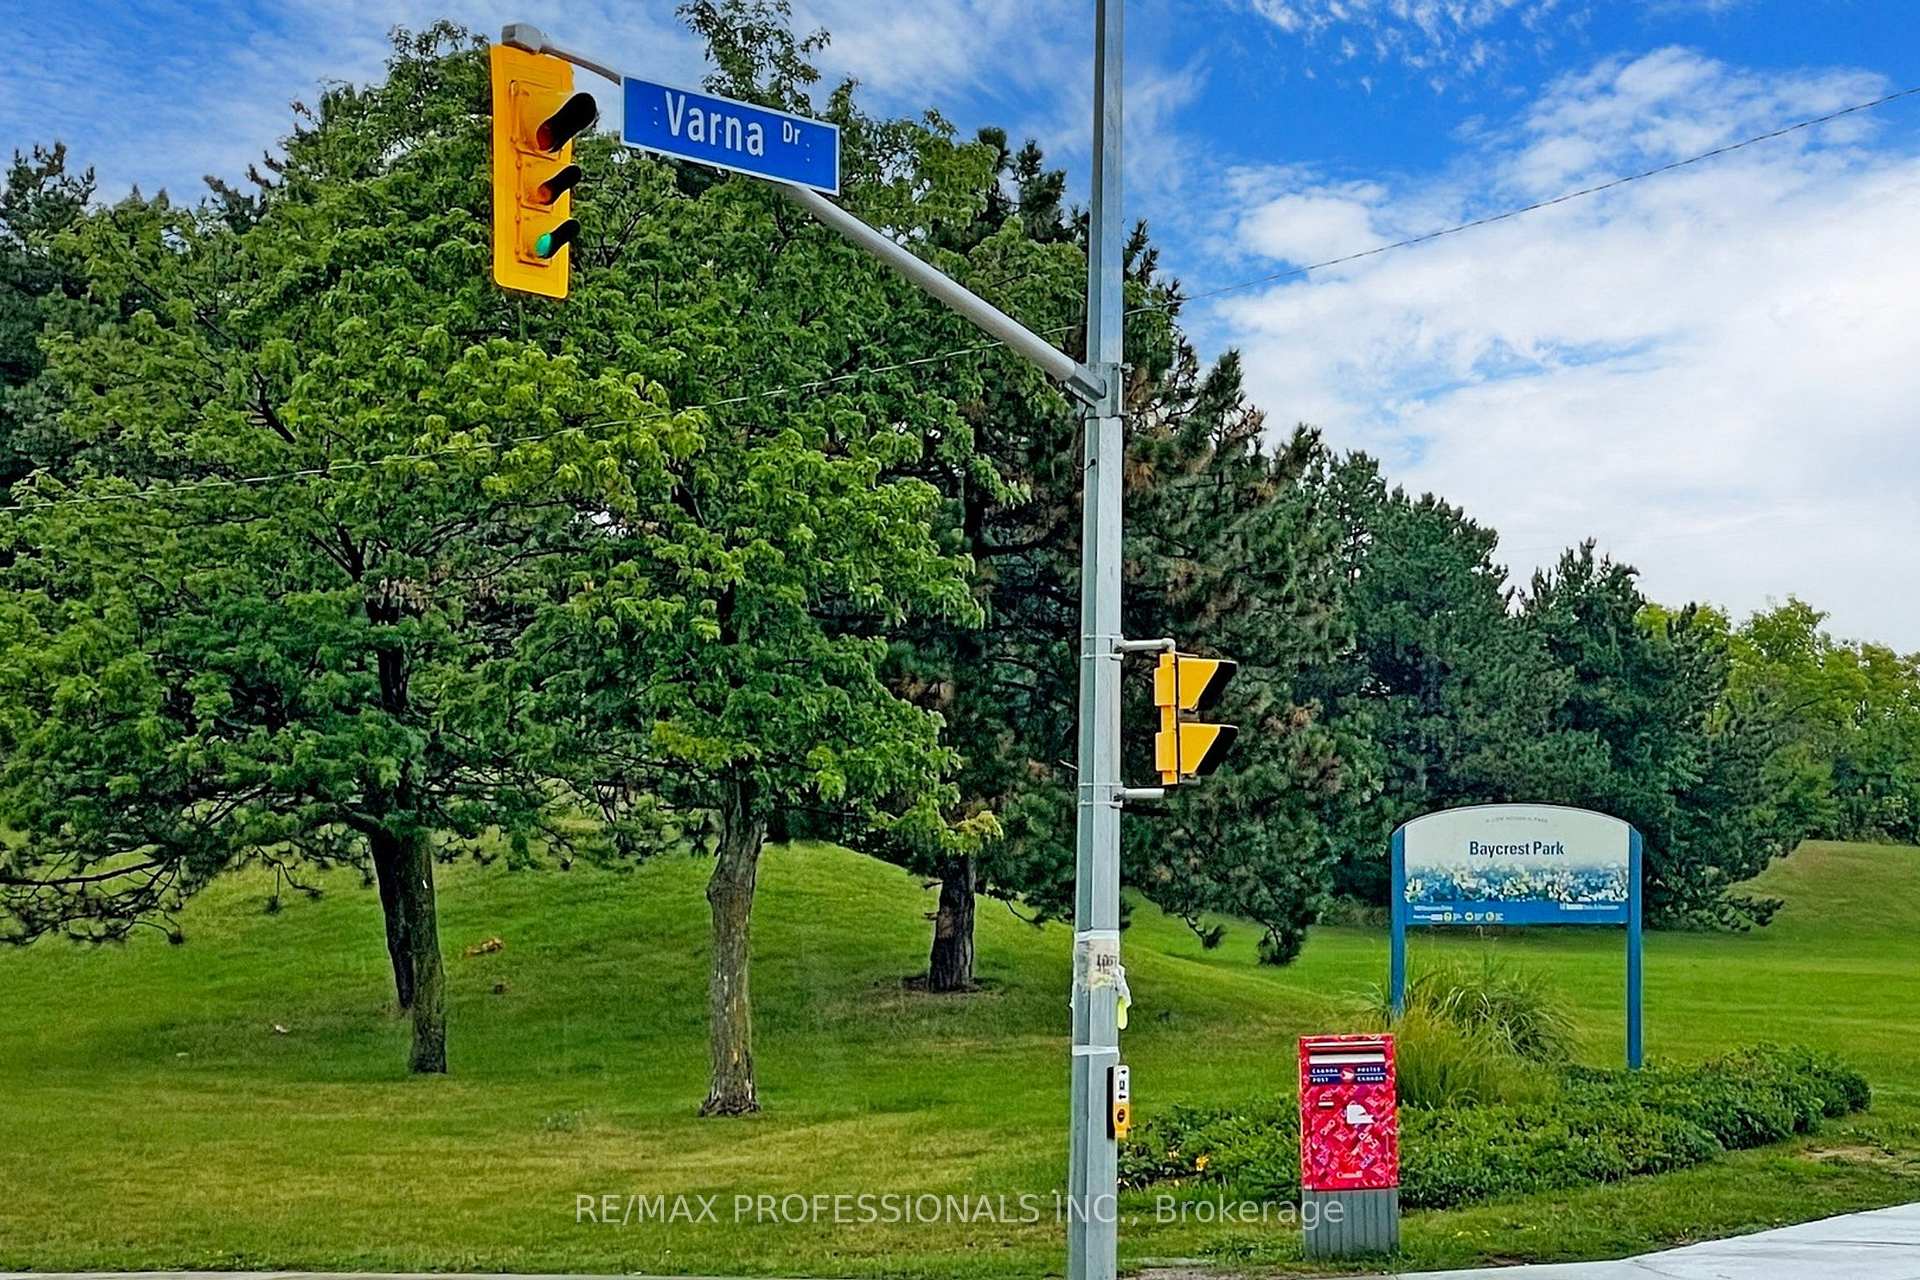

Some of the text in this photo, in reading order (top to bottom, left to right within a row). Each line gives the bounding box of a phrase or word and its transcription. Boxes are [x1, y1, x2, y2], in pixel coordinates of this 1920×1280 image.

[665, 90, 801, 157] Varna Dr
[1469, 841, 1564, 858] Baycrest Park
